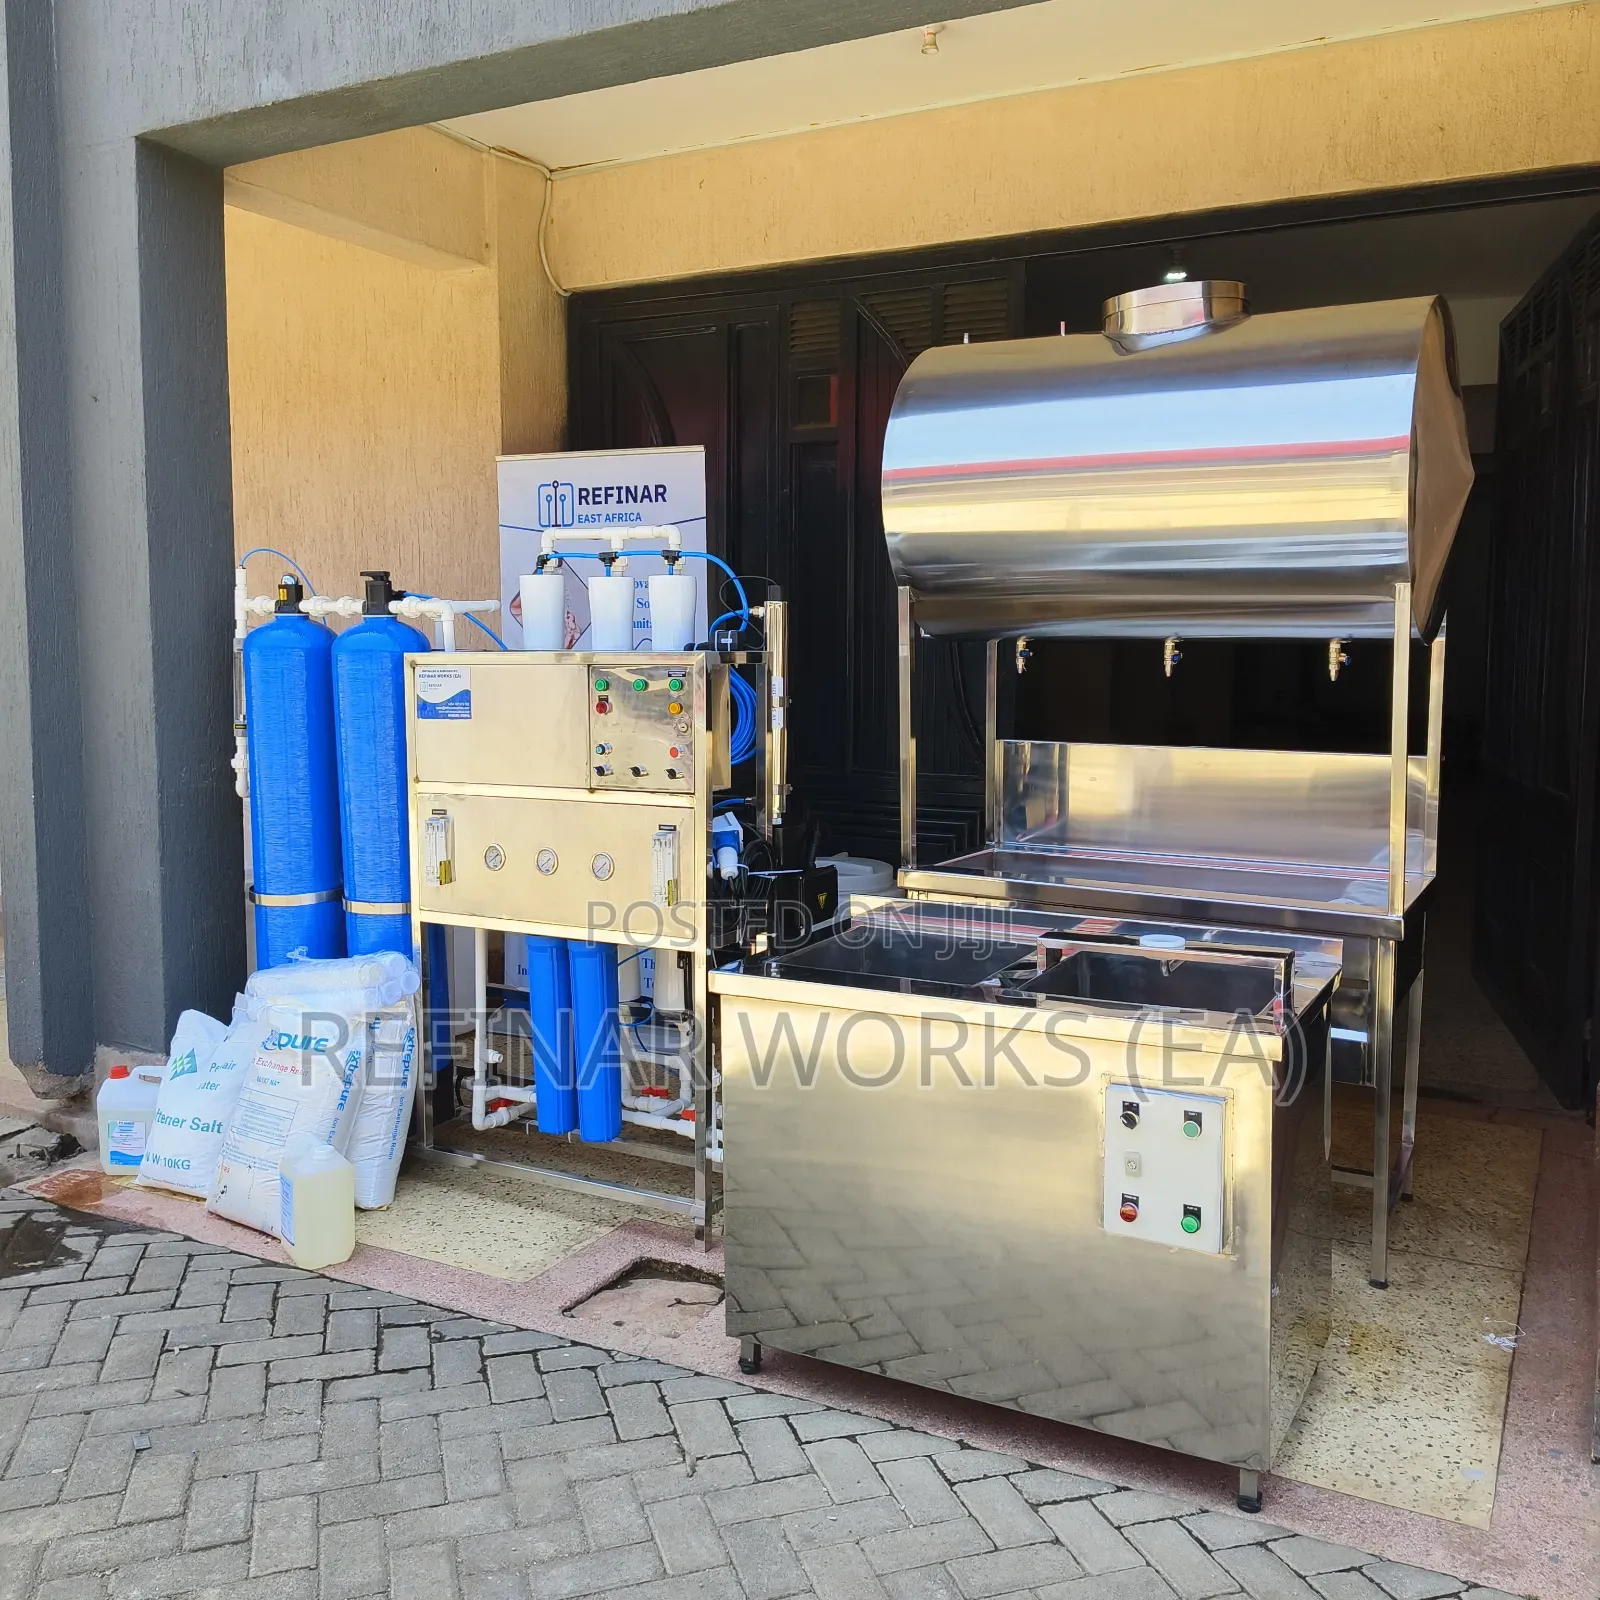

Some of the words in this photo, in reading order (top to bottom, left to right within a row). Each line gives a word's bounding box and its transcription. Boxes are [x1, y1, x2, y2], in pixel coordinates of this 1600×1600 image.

[578, 484, 667, 506] REFINAR
[577, 513, 602, 524] EAST
[604, 512, 642, 523] AFRICA
[256, 1057, 289, 1073] Exchange
[401, 1027, 415, 1089] extrepure
[197, 1080, 221, 1091] ater
[155, 1108, 188, 1129] ftener
[189, 1116, 225, 1134] Salt
